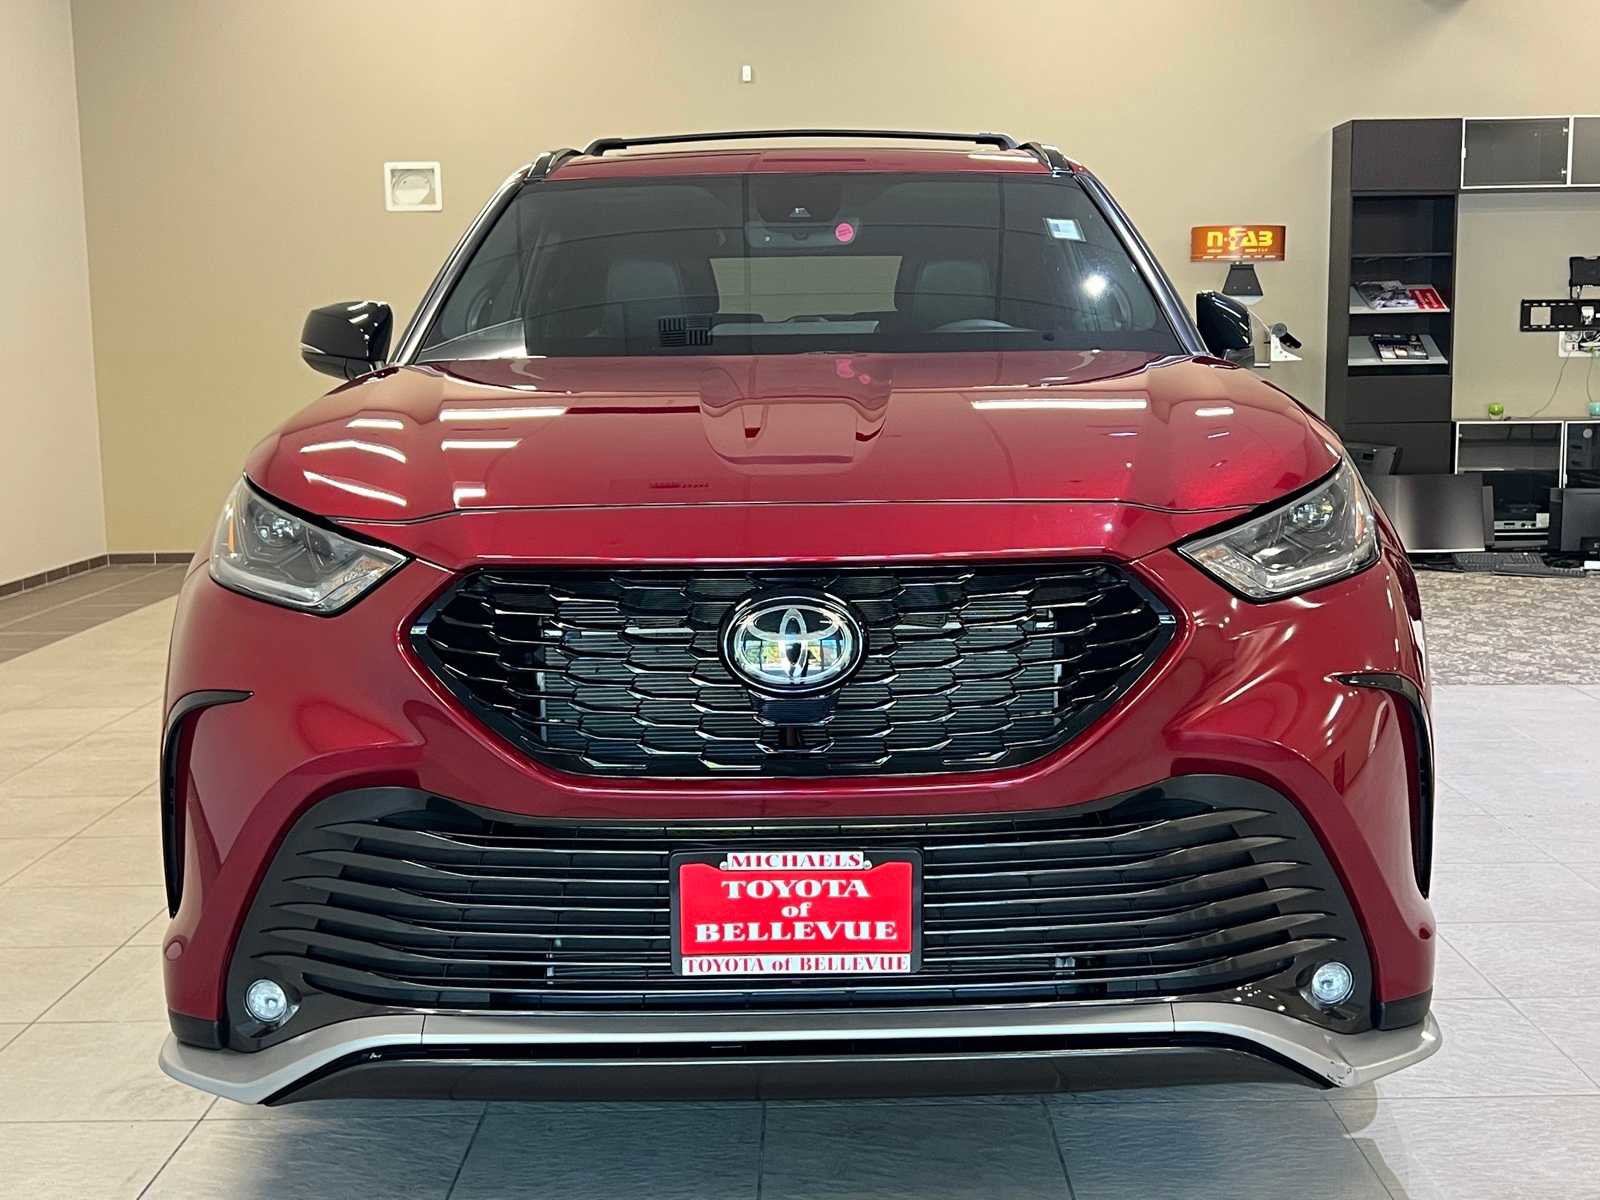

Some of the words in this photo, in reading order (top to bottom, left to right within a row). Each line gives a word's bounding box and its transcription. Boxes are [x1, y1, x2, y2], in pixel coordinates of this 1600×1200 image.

[731, 853, 861, 869] MICHAELS
[721, 879, 870, 899] TOYOTA
[781, 902, 812, 918] of
[695, 921, 898, 943] BELLEVUE
[684, 957, 764, 973] TOYOTA
[772, 957, 792, 972] of
[799, 954, 908, 972] BELLEVUE
